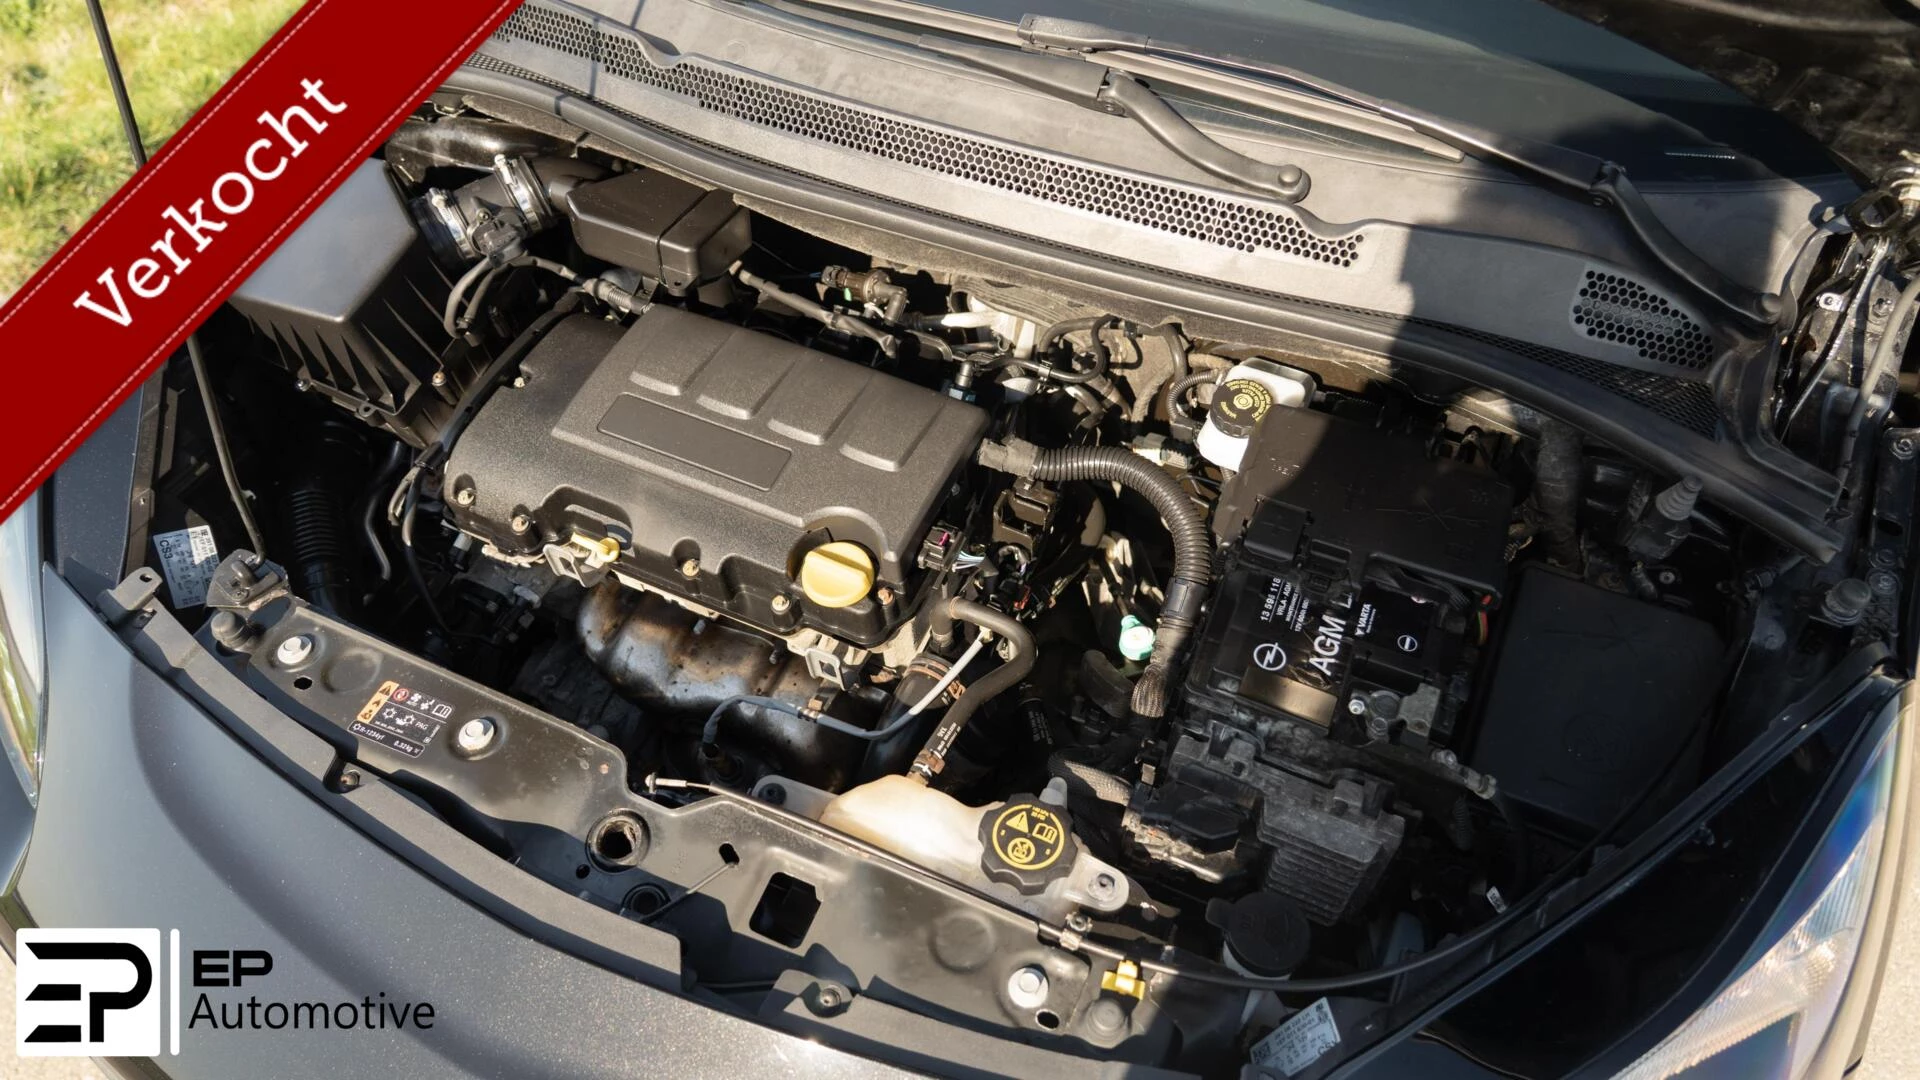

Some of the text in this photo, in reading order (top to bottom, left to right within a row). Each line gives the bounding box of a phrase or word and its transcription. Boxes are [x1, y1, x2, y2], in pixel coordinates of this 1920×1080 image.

[159, 540, 174, 559] CS3
[1260, 611, 1270, 620] 13
[1270, 578, 1281, 592] 118
[1277, 600, 1287, 616] VRLA
[1358, 603, 1372, 628] VARTA
[1309, 615, 1346, 676] AGM
